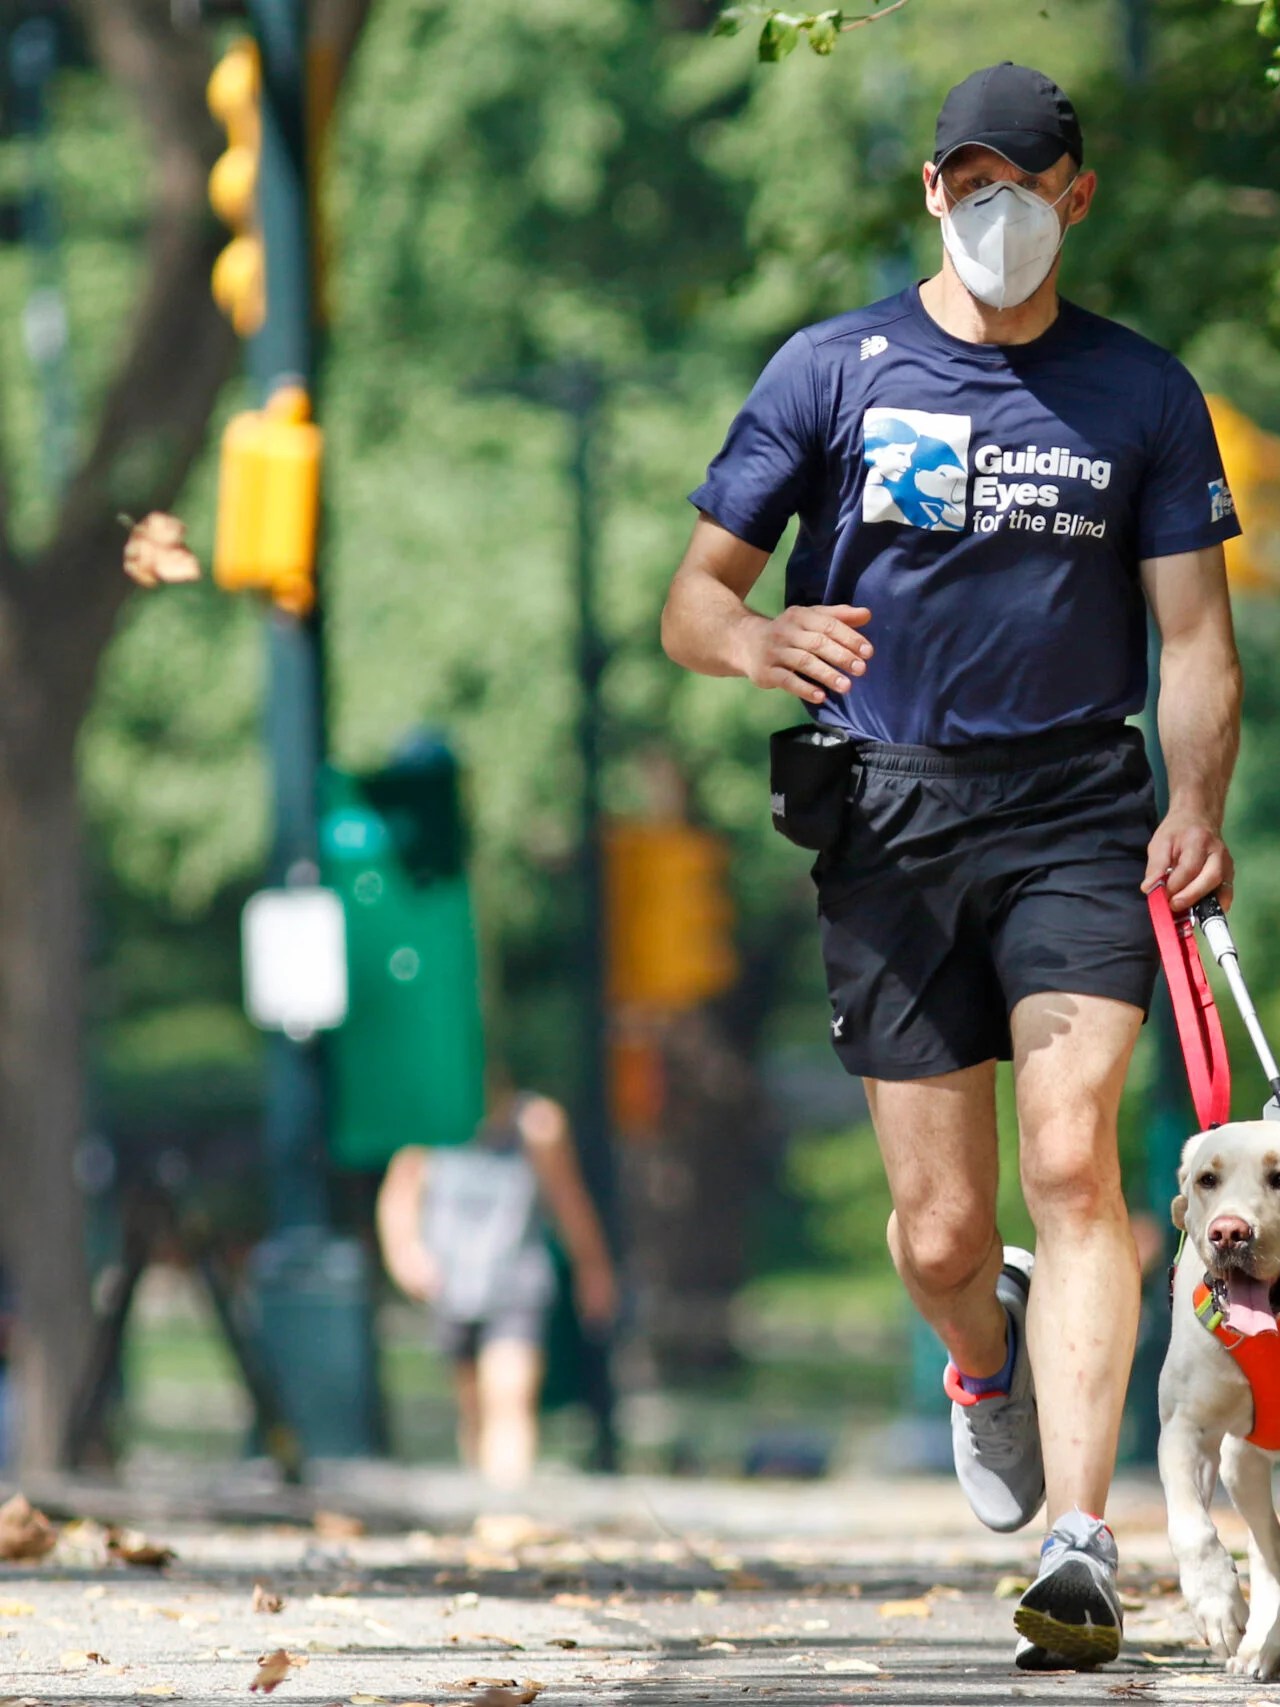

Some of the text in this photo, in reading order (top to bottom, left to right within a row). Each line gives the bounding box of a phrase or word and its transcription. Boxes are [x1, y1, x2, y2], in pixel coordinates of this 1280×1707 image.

[974, 444, 1111, 490] Guiding
[972, 476, 1060, 512] Eyes
[972, 509, 1106, 539] for the Blind
